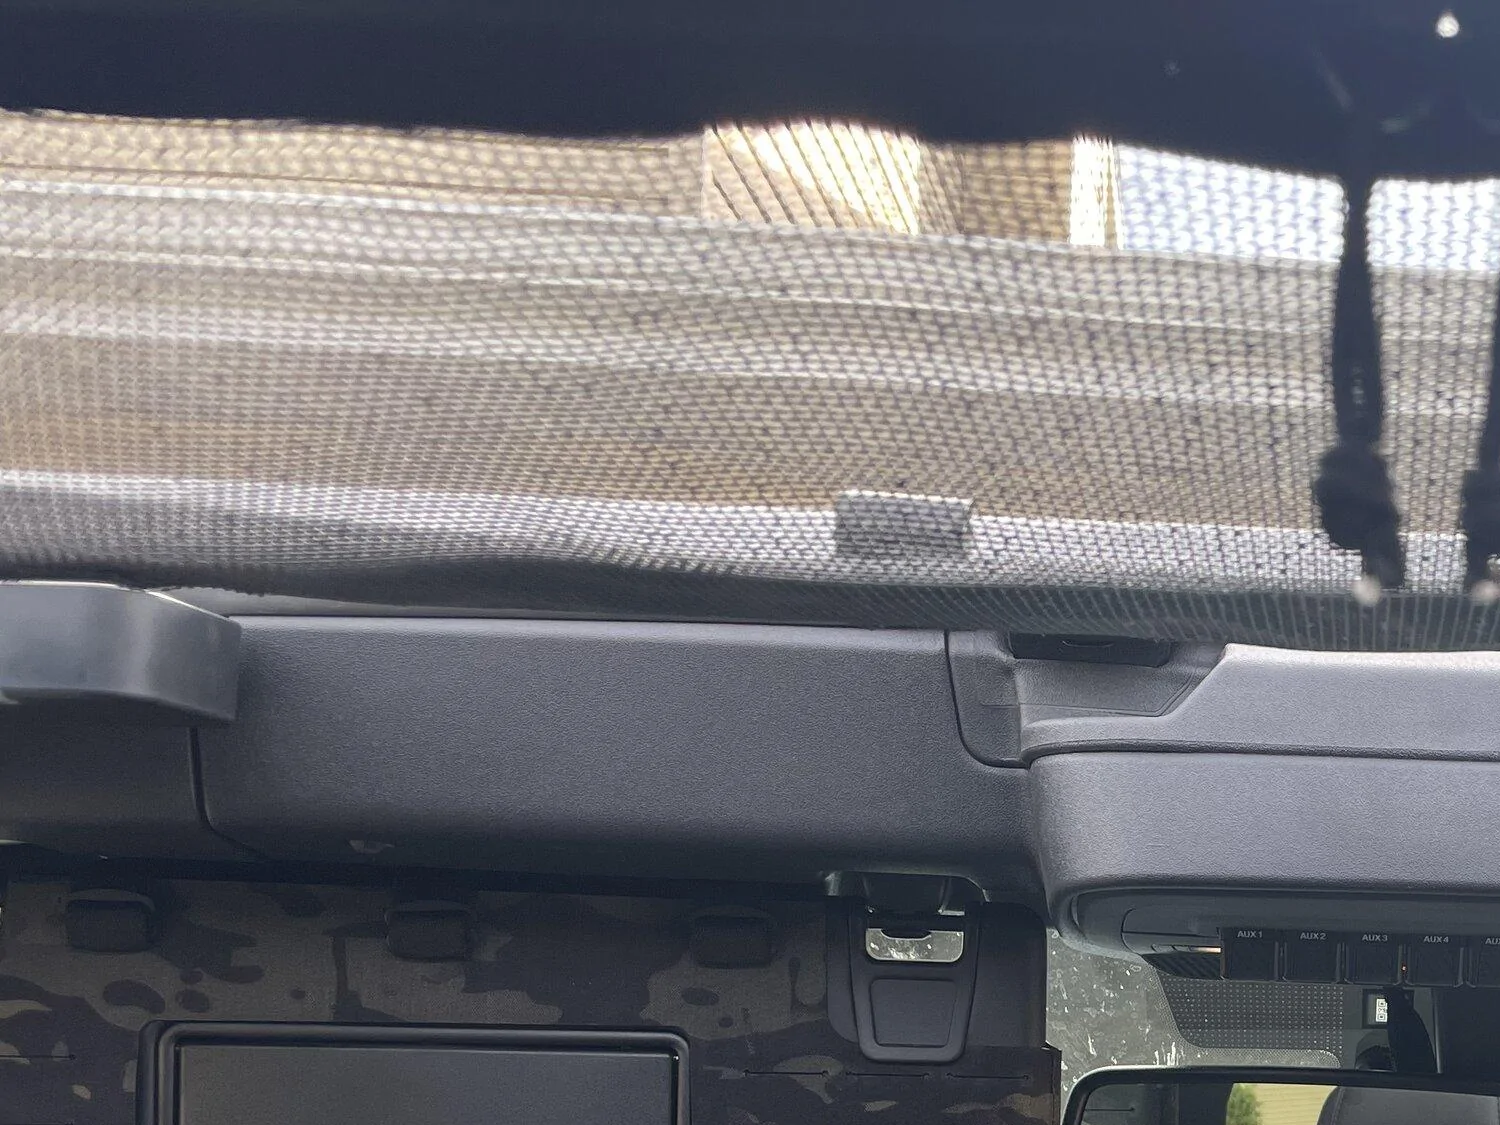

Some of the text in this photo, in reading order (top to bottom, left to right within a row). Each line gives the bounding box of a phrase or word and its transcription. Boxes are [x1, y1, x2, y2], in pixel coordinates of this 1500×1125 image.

[1237, 930, 1257, 938] AUX
[1300, 932, 1321, 940] AUX
[1362, 934, 1382, 942] AUX
[1424, 935, 1443, 943] AUX
